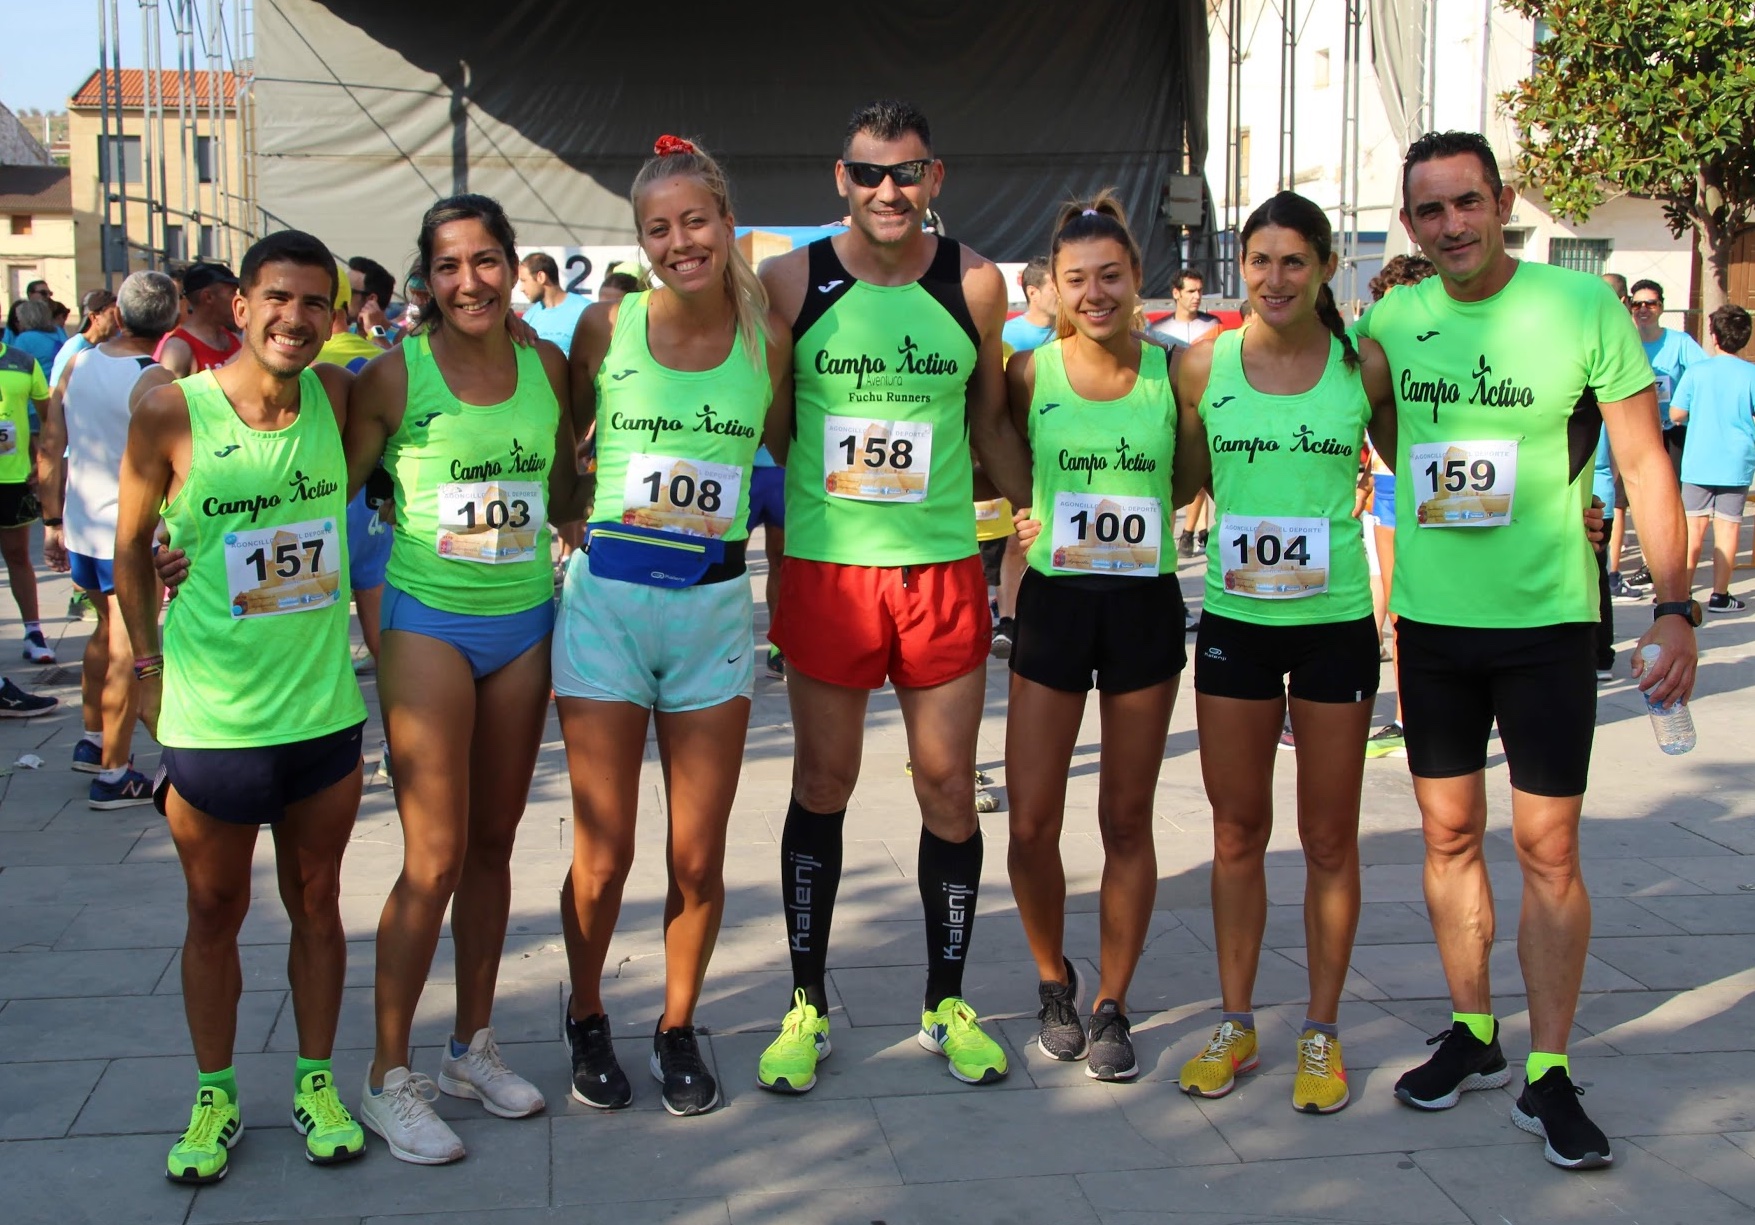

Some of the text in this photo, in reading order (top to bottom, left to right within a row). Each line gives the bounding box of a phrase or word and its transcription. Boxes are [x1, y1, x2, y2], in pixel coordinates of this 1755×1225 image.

[565, 254, 592, 294] 2
[815, 335, 958, 389] Campo Activo
[866, 374, 903, 386] Aventura
[1400, 354, 1534, 423] Campo Activo
[849, 392, 931, 403] Fuchu Runners
[611, 404, 755, 442] Campo Activo
[839, 435, 913, 469] 158
[1059, 437, 1156, 485] Campo Activo
[1213, 424, 1353, 464] Campo Activo
[450, 459, 502, 482] Campo
[1425, 459, 1496, 493] 159
[643, 471, 721, 512] 108
[203, 495, 281, 523] Campo
[458, 499, 530, 529] 103
[1070, 510, 1146, 544] 100
[246, 538, 324, 581] 157
[1232, 534, 1310, 566] 104
